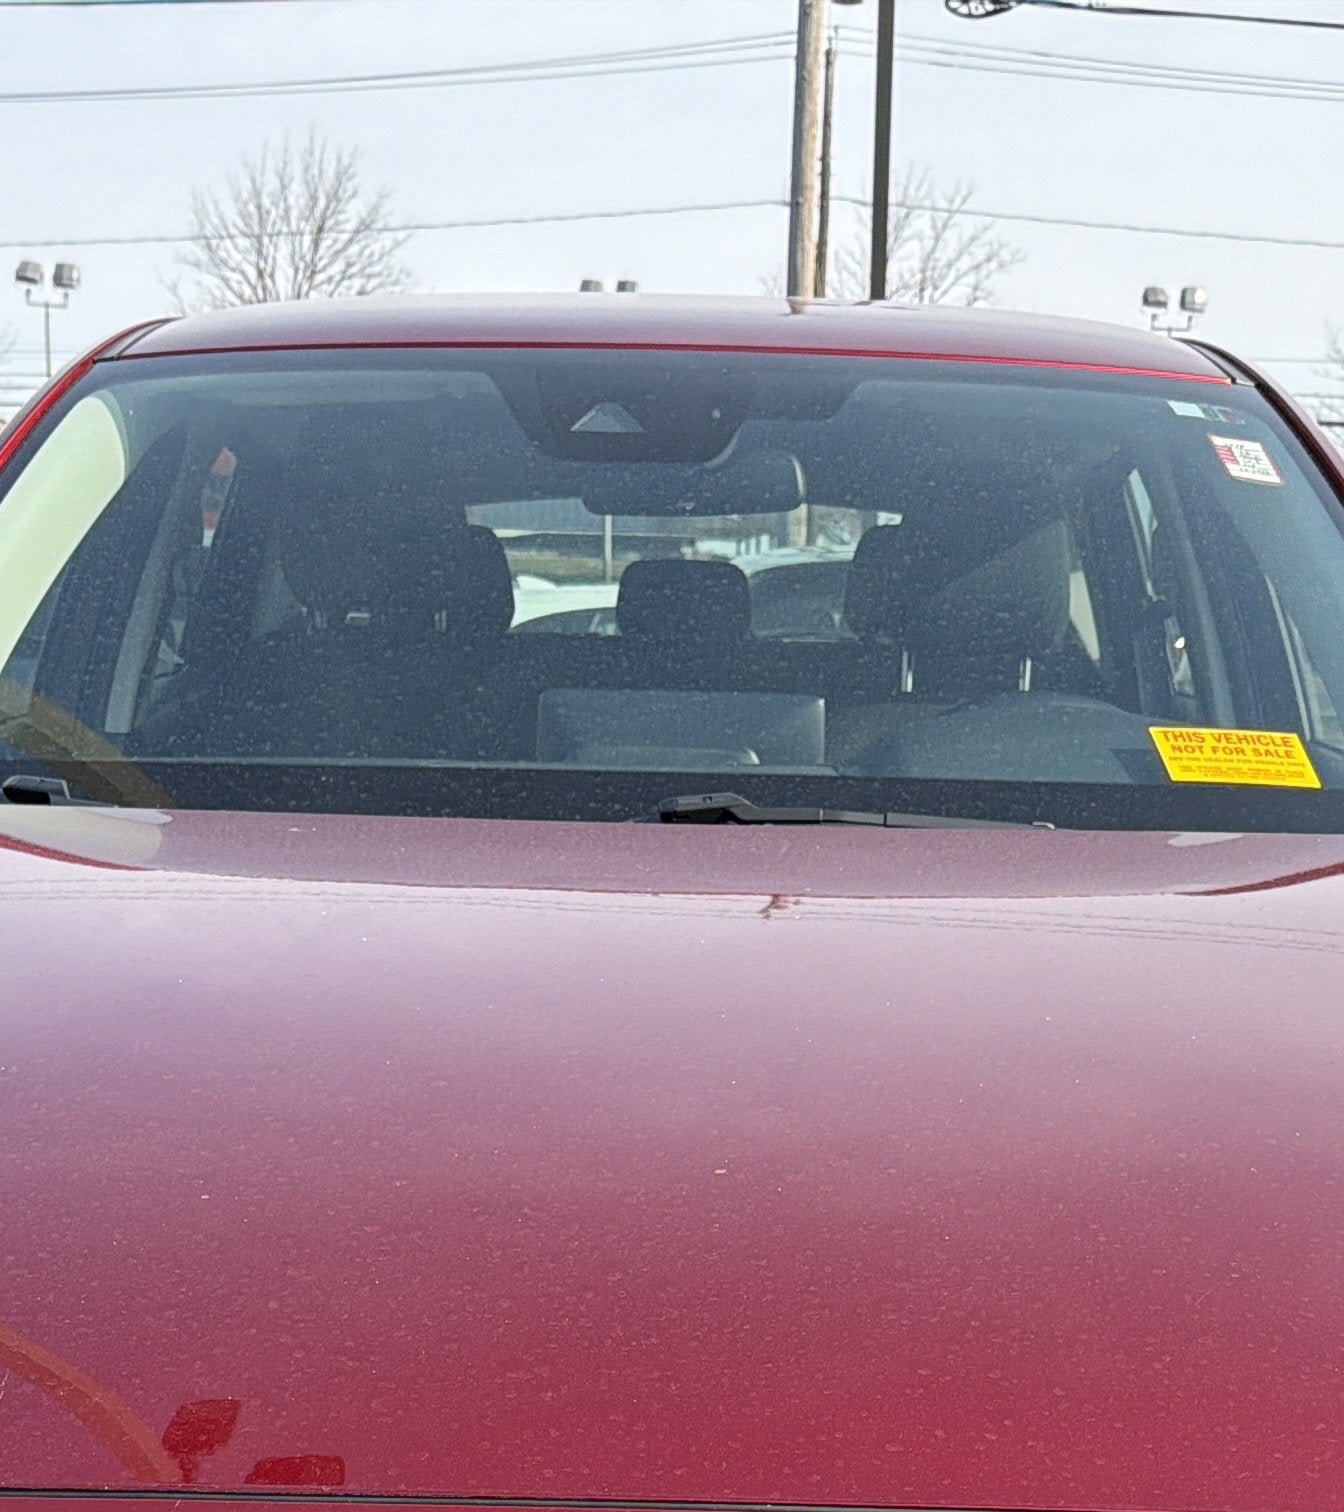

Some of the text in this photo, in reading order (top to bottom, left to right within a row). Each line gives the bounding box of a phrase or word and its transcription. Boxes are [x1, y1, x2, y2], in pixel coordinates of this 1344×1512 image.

[1159, 730, 1296, 749] THIS VEHICLE
[1171, 744, 1297, 760] NOT FOR SALE
